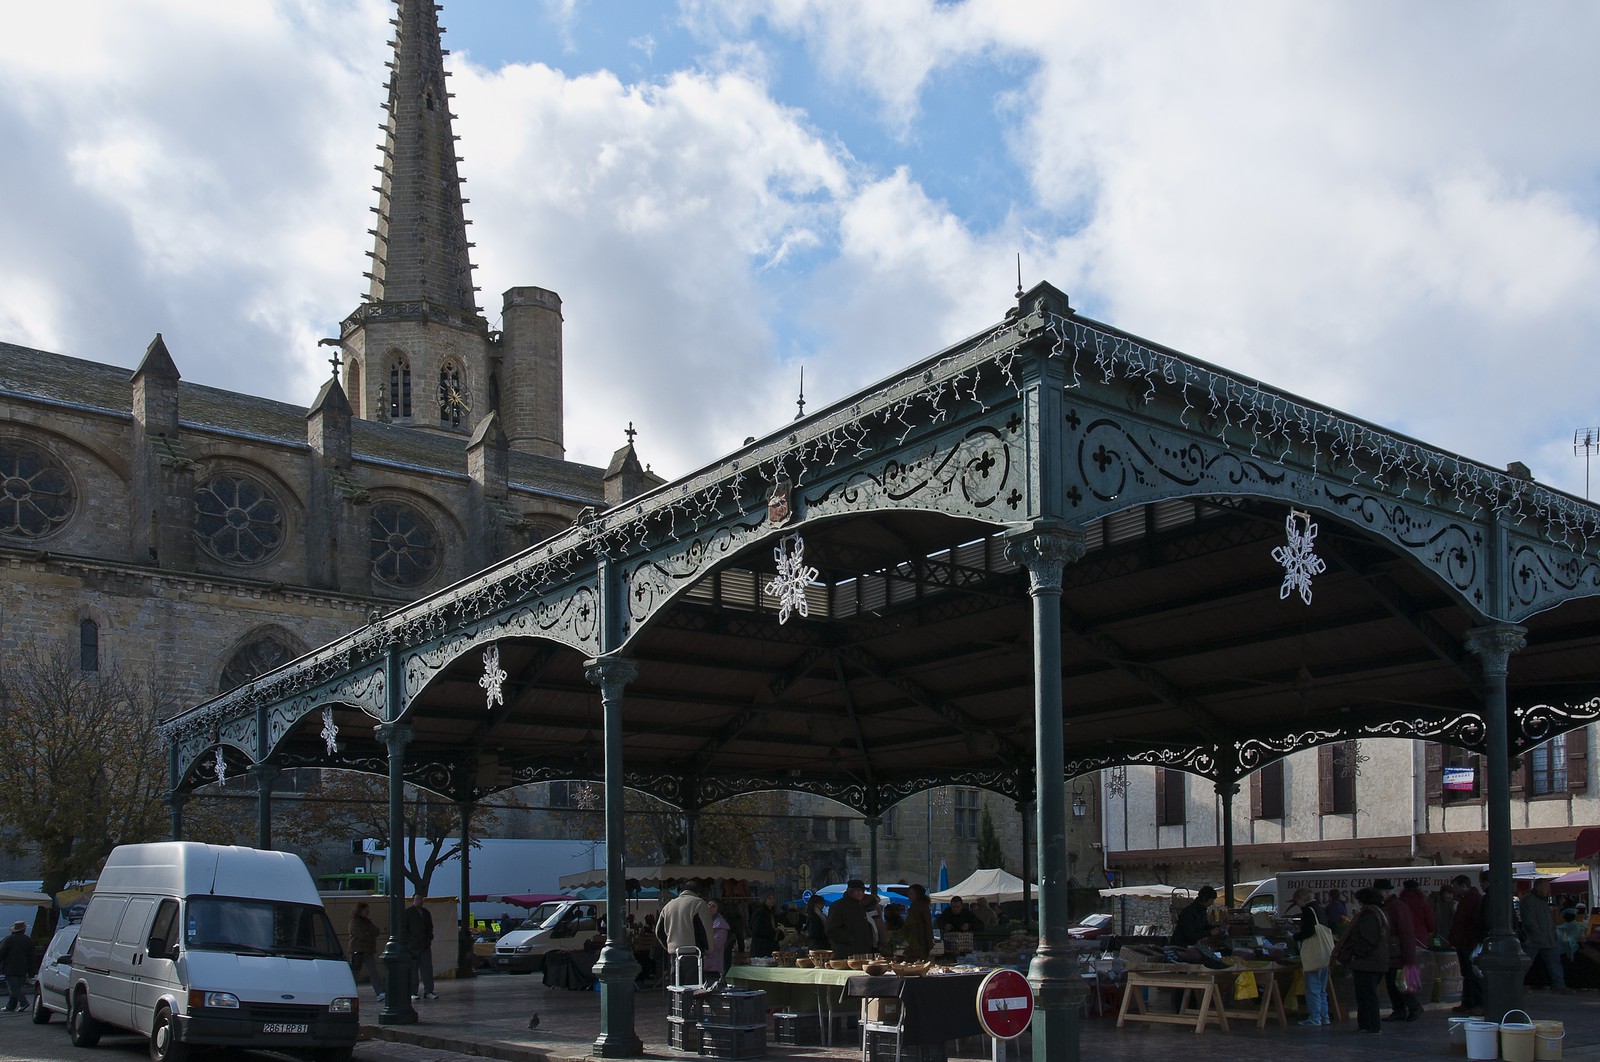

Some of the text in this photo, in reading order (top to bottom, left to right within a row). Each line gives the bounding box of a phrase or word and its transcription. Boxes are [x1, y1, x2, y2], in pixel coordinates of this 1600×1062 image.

[1287, 879, 1348, 889] BOUCHERIE
[264, 1023, 284, 1033] 2861
[297, 1024, 306, 1033] 81
